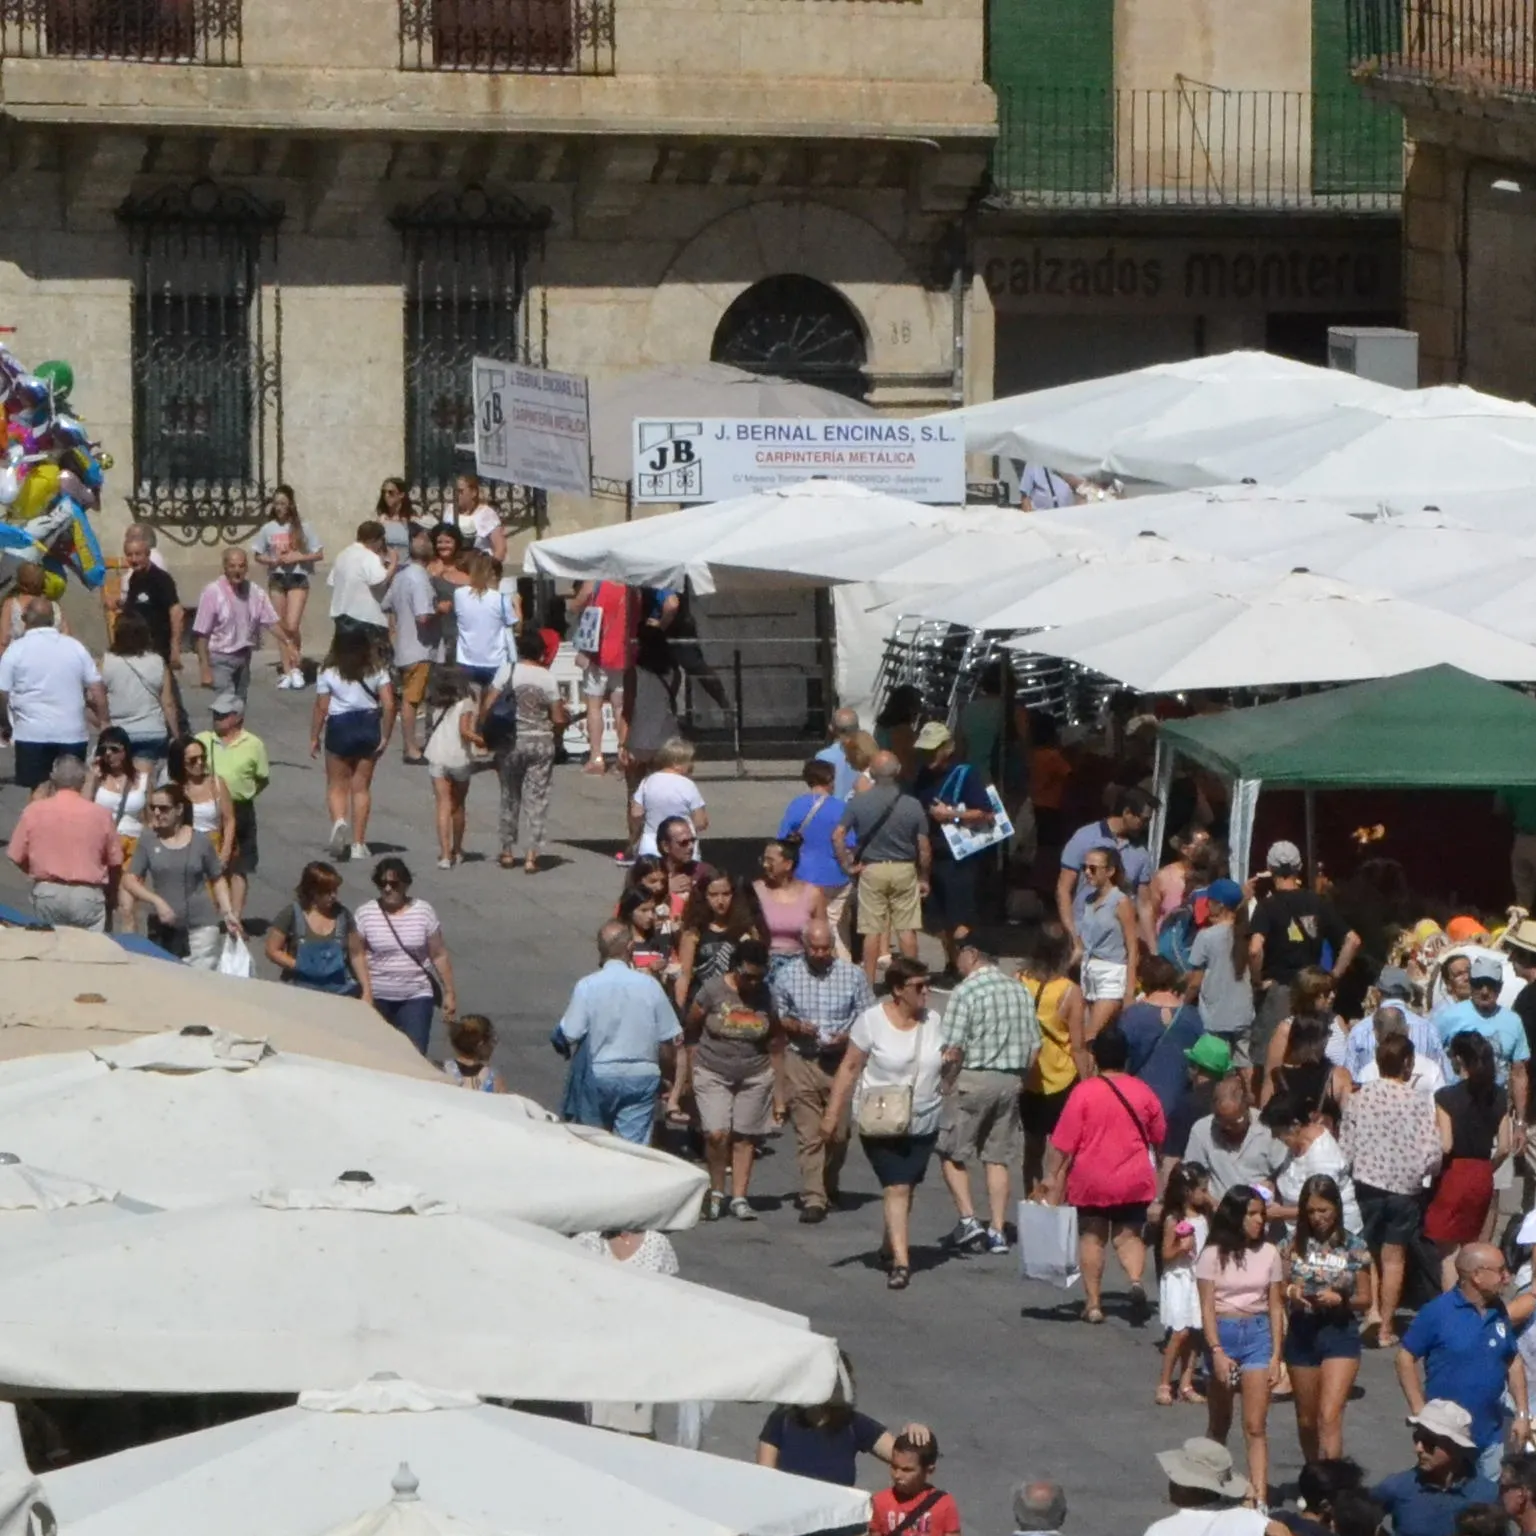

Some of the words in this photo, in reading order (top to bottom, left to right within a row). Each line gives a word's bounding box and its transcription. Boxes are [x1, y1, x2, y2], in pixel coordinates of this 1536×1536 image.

[986, 247, 1164, 298] calzados
[1184, 248, 1380, 298] montero
[714, 424, 731, 441] J.
[736, 424, 817, 441] BERNAL
[824, 425, 916, 442] ENCINAS,
[920, 425, 956, 442] S.L.
[755, 450, 845, 463] CARPINTERÍA
[848, 450, 916, 463] METÁLICA
